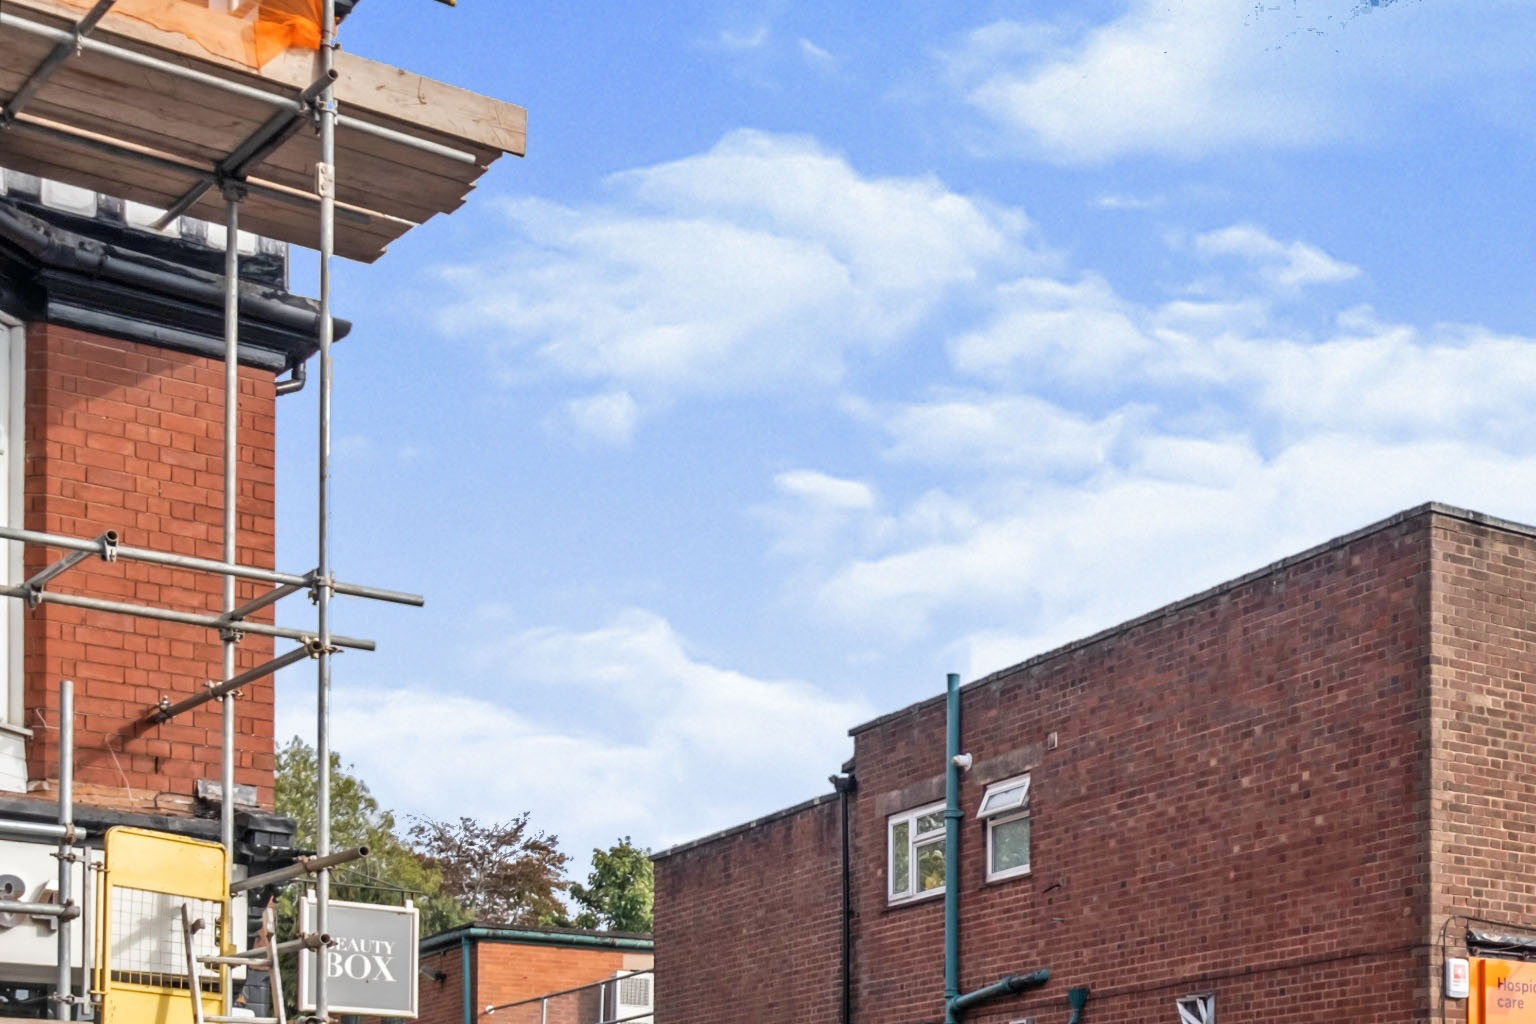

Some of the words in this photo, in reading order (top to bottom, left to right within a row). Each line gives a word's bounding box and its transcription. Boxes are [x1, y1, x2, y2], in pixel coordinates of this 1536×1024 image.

[329, 936, 396, 955] EAUTY
[327, 951, 397, 982] BOX
[1497, 997, 1525, 1009] care
